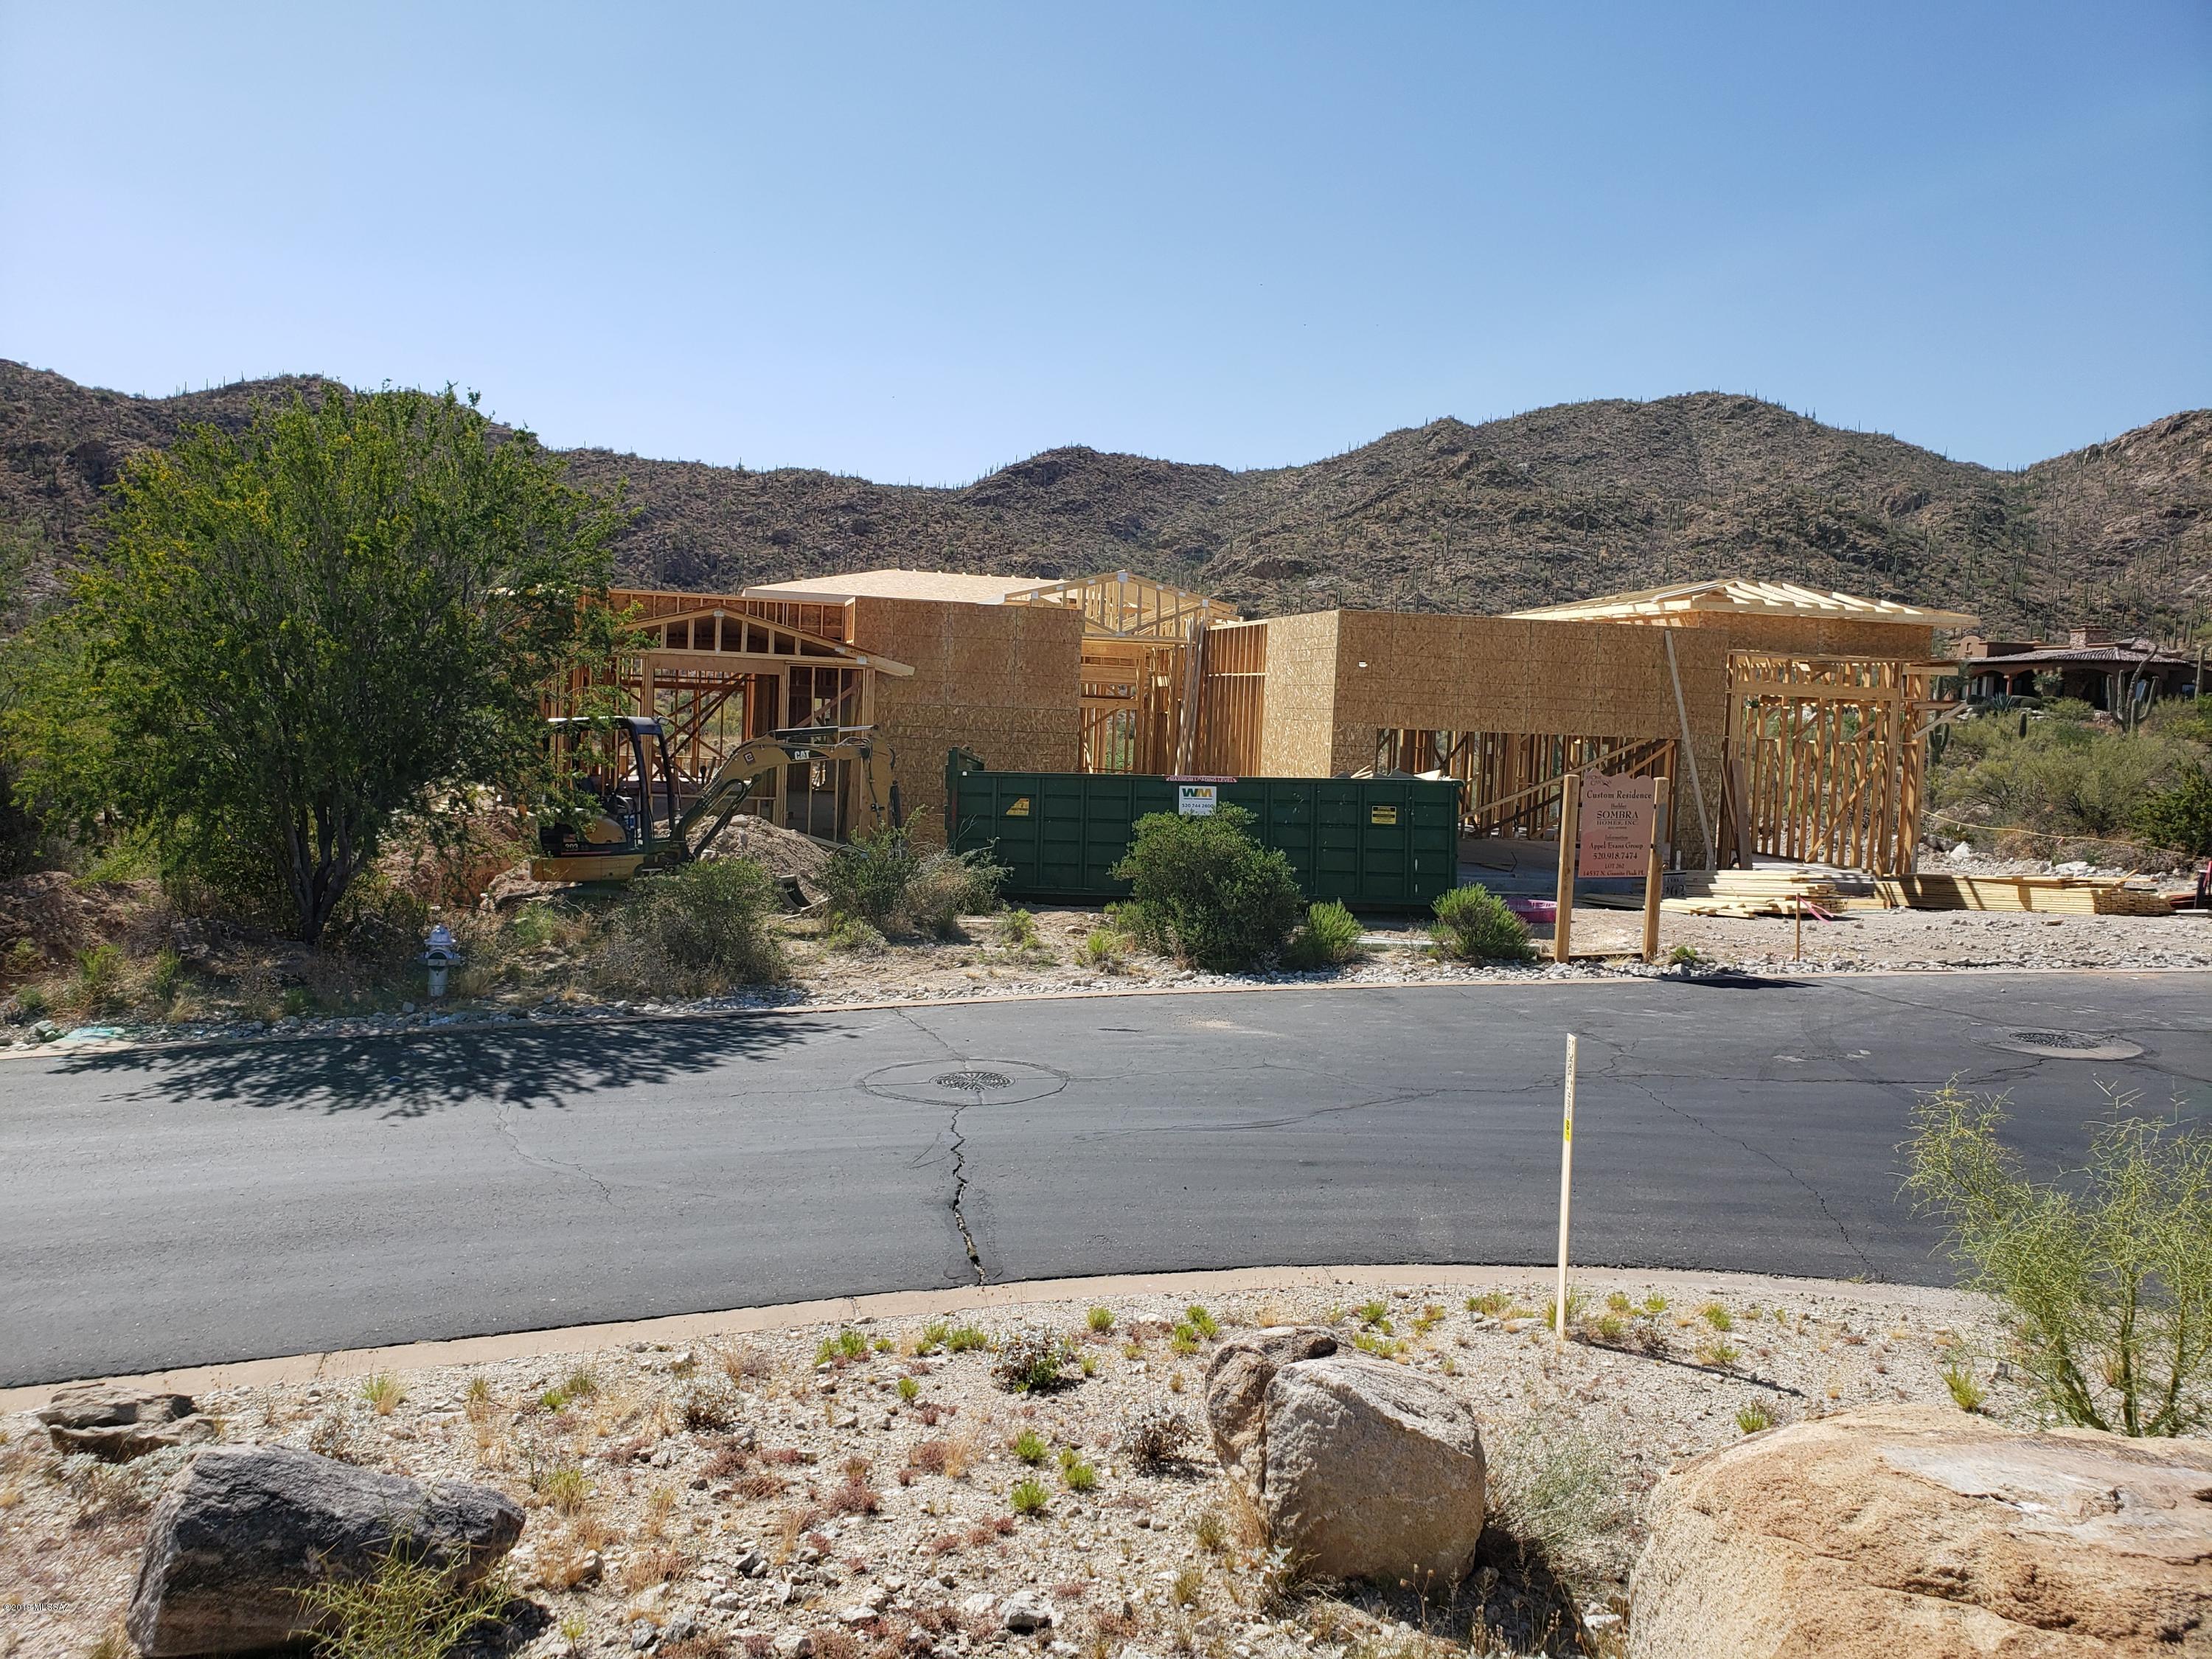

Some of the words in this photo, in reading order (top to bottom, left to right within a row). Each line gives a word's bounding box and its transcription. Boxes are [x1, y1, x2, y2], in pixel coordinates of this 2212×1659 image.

[794, 750, 810, 760] CAT
[1182, 788, 1213, 797] WM
[1587, 790, 1614, 799] Custom
[1616, 789, 1652, 799] Residence
[1596, 810, 1638, 818] SOMBRA
[1589, 841, 1606, 849] Appel
